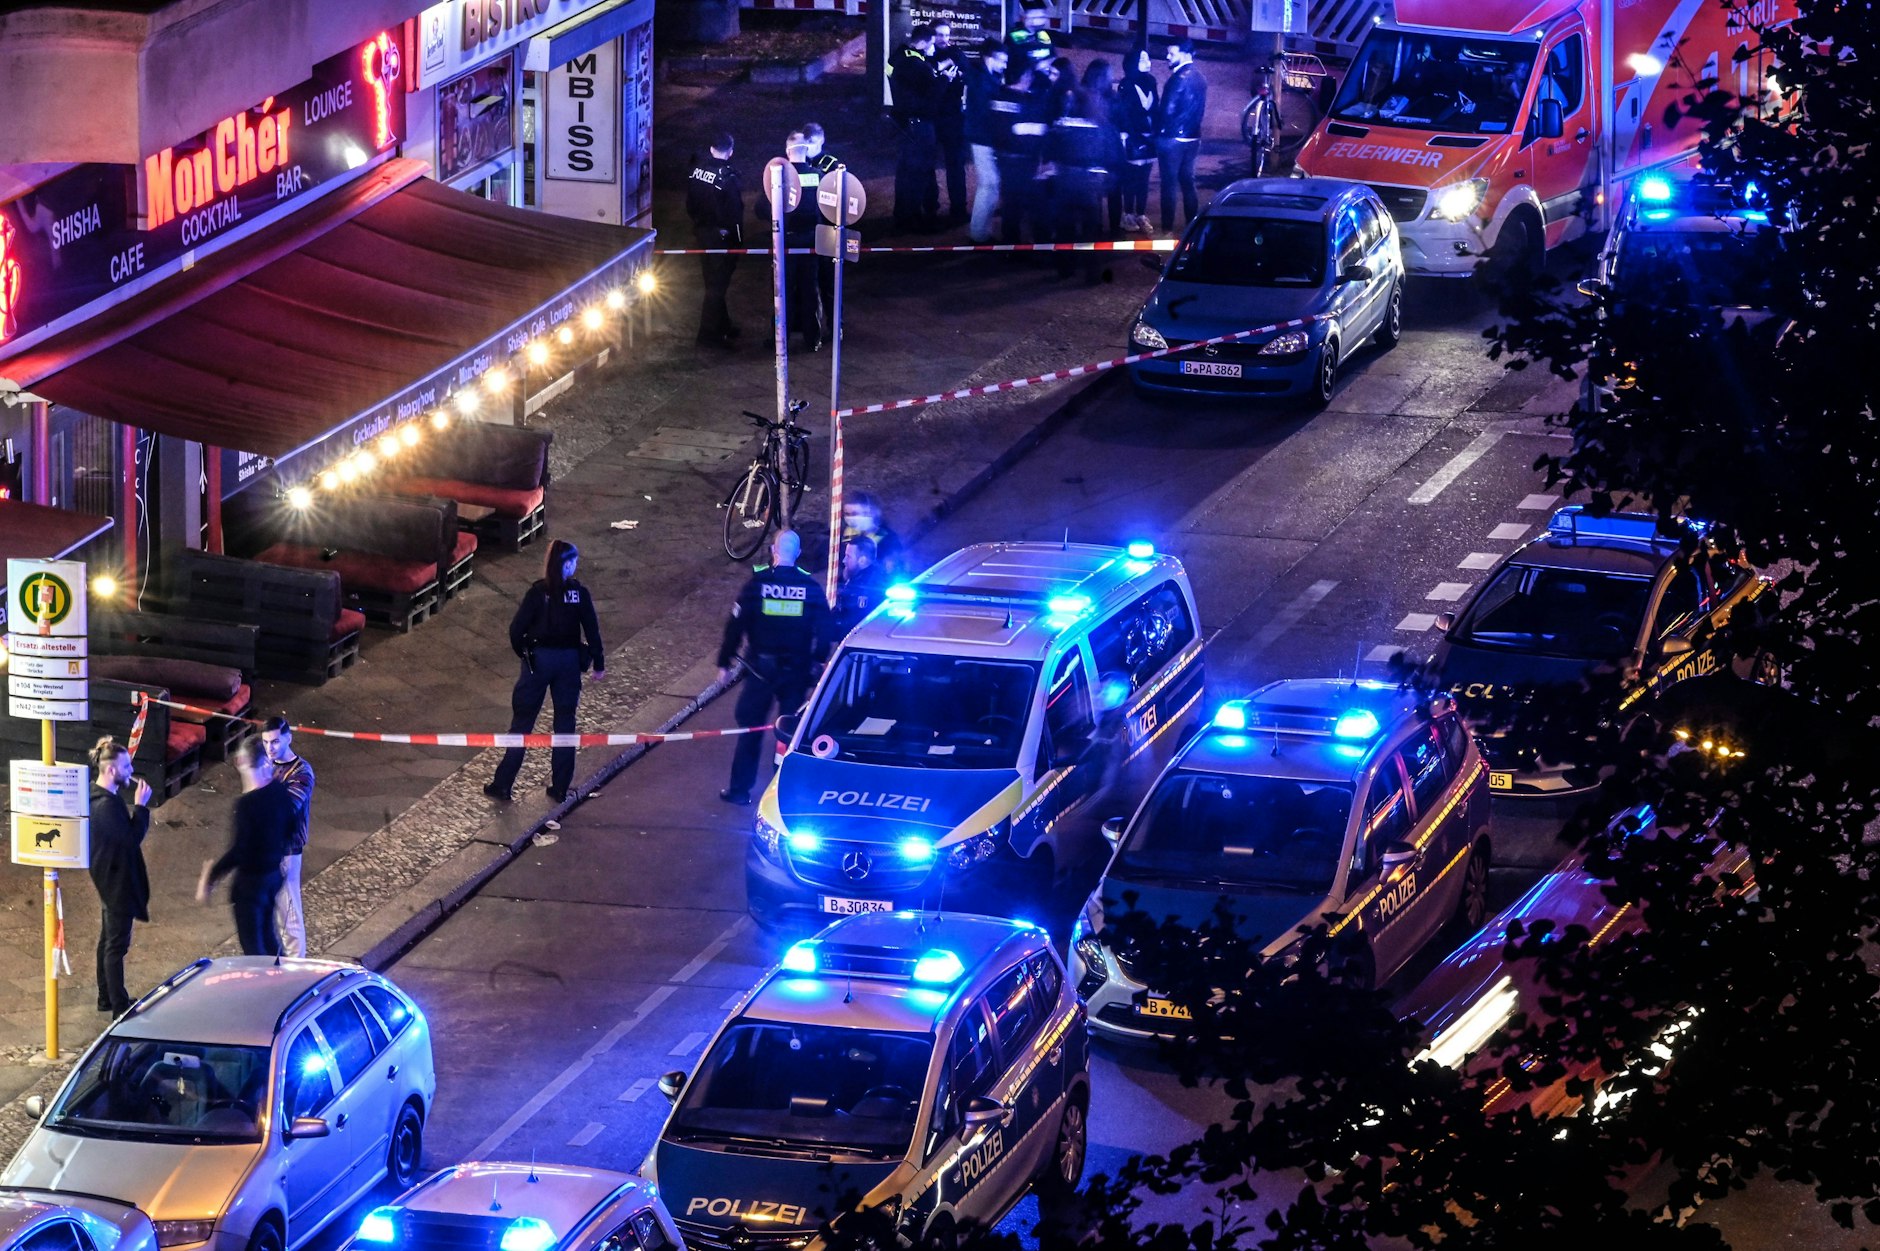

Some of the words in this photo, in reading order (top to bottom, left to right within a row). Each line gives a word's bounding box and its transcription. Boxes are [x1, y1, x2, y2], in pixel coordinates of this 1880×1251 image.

[462, 0, 550, 51] BISTR
[910, 9, 920, 17] Es
[922, 9, 935, 18] tut
[937, 9, 956, 19] sich
[951, 20, 979, 30] benan
[305, 80, 352, 126] LOUNGE
[566, 53, 597, 172] MBISS
[1324, 142, 1444, 169] FEUERWEHR
[276, 166, 302, 200] BAR
[693, 167, 716, 184] POLIZEI
[52, 203, 101, 249] SHISHA
[181, 195, 242, 247] COCKTAIL
[110, 242, 145, 283] CAFE
[507, 331, 528, 353] Shisha
[531, 316, 546, 338] Café
[550, 302, 573, 326] Lounge
[1214, 365, 1240, 376] 3862
[563, 589, 580, 604] IZEI
[761, 584, 806, 600] POLIZEI
[16, 640, 76, 652] Ersatzaltestelle
[818, 791, 931, 812] POLIZEI
[846, 901, 886, 913] 30836
[1380, 872, 1416, 922] POLIZEI
[962, 1128, 1004, 1188] POLIZEI
[686, 1197, 806, 1225] POLIZEI
